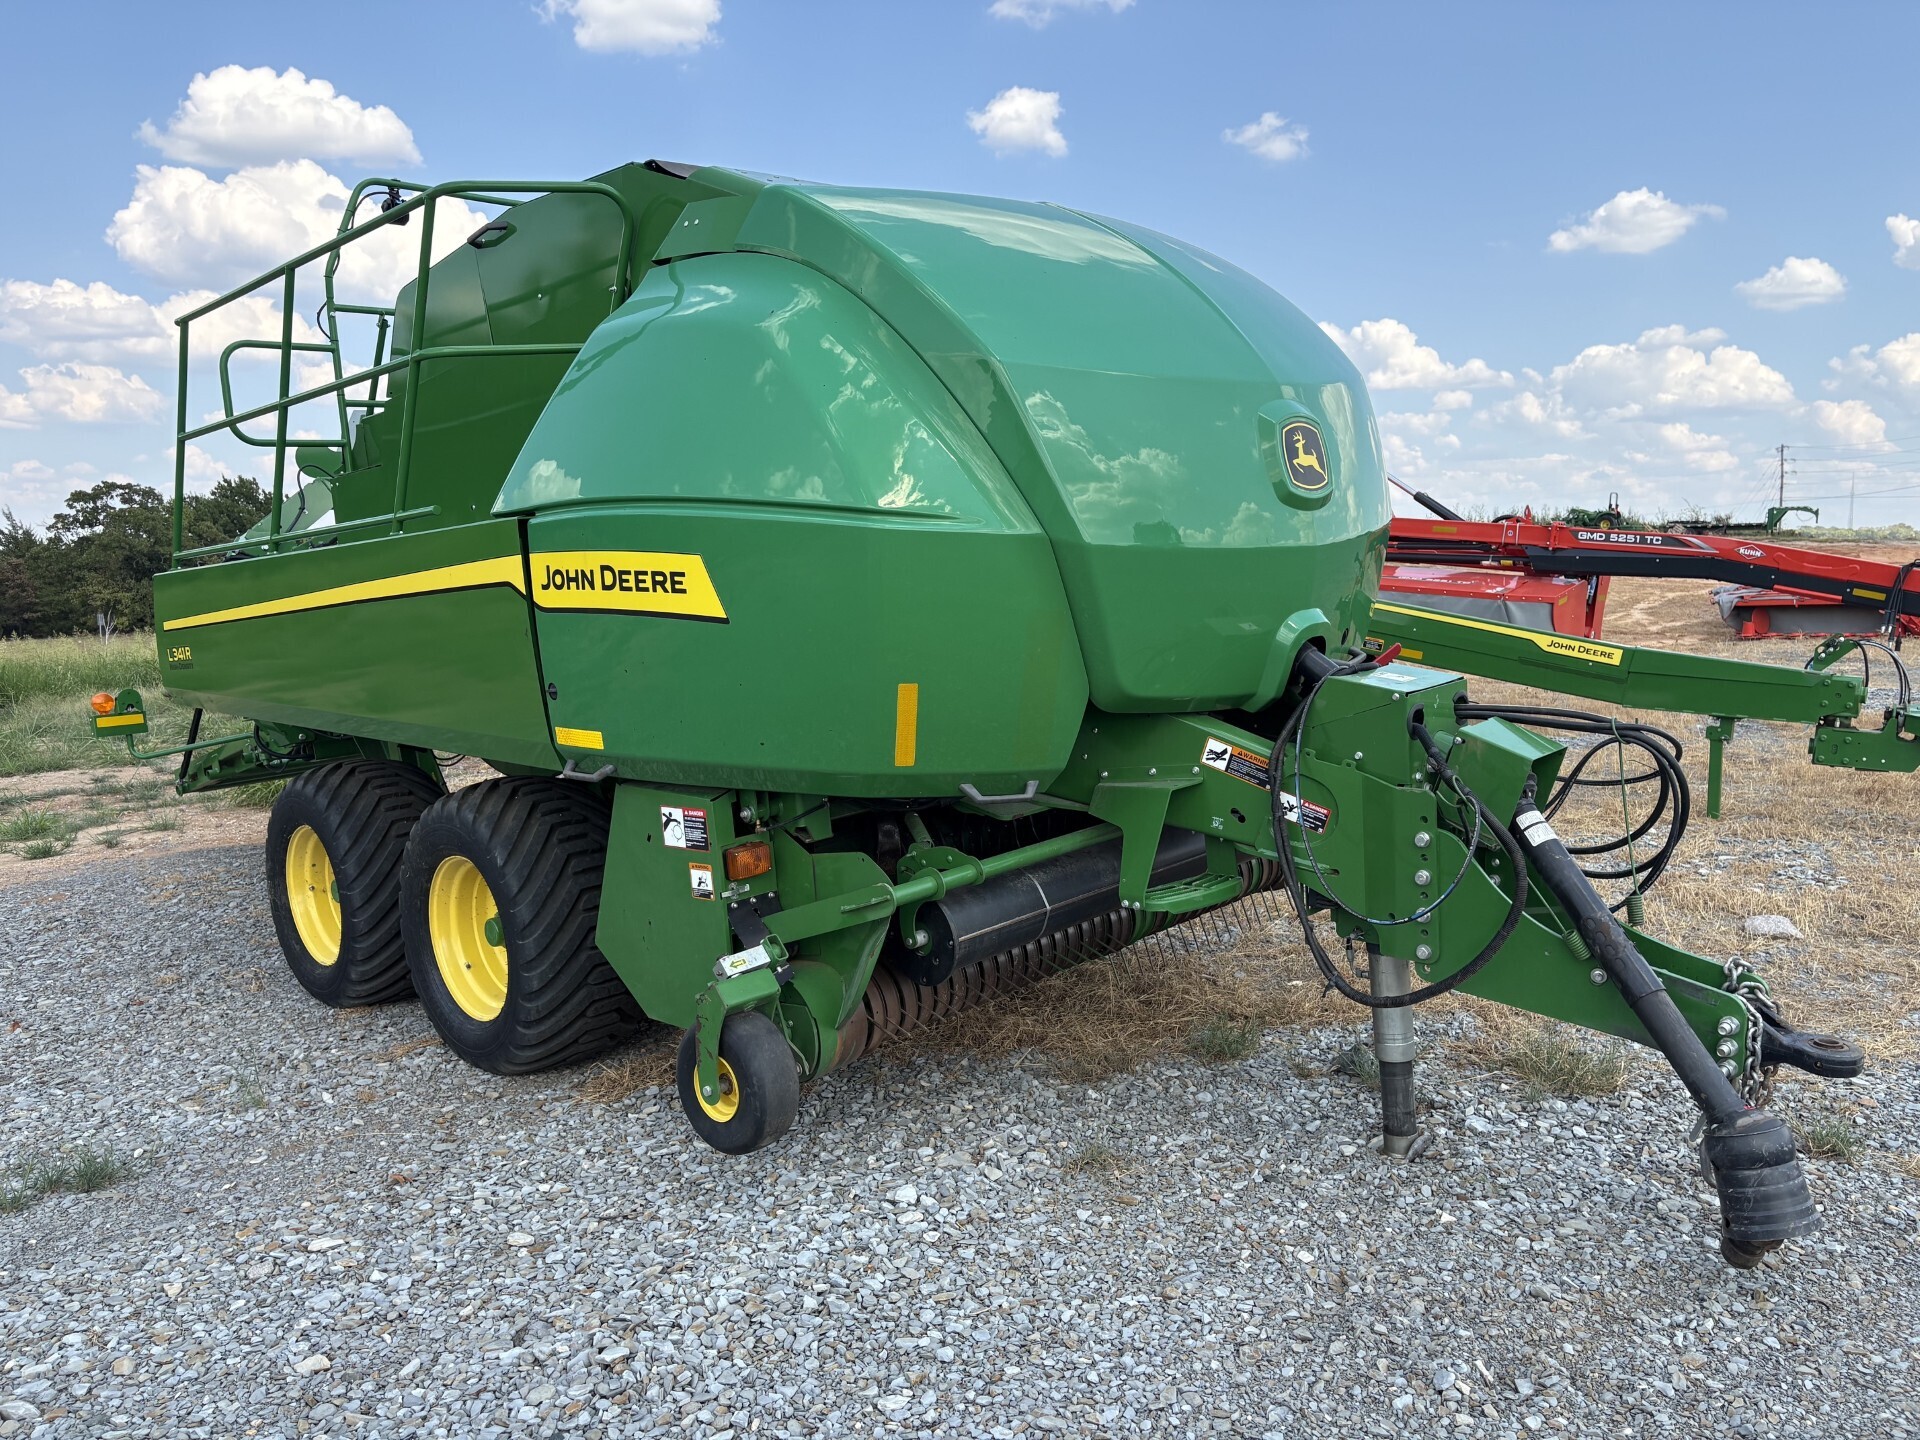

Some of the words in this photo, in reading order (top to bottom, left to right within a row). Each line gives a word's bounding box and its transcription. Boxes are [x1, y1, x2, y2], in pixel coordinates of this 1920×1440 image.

[1578, 532, 1605, 541] GMD
[1610, 533, 1640, 543] 5251
[1645, 535, 1662, 544] TC
[1740, 548, 1761, 557] KUHN
[541, 564, 595, 591] JOHN
[600, 564, 687, 594] DEERE
[167, 646, 192, 661] L341R
[1547, 640, 1576, 651] JOHN
[1578, 645, 1614, 659] DEERE
[1243, 751, 1270, 767] WARNIN
